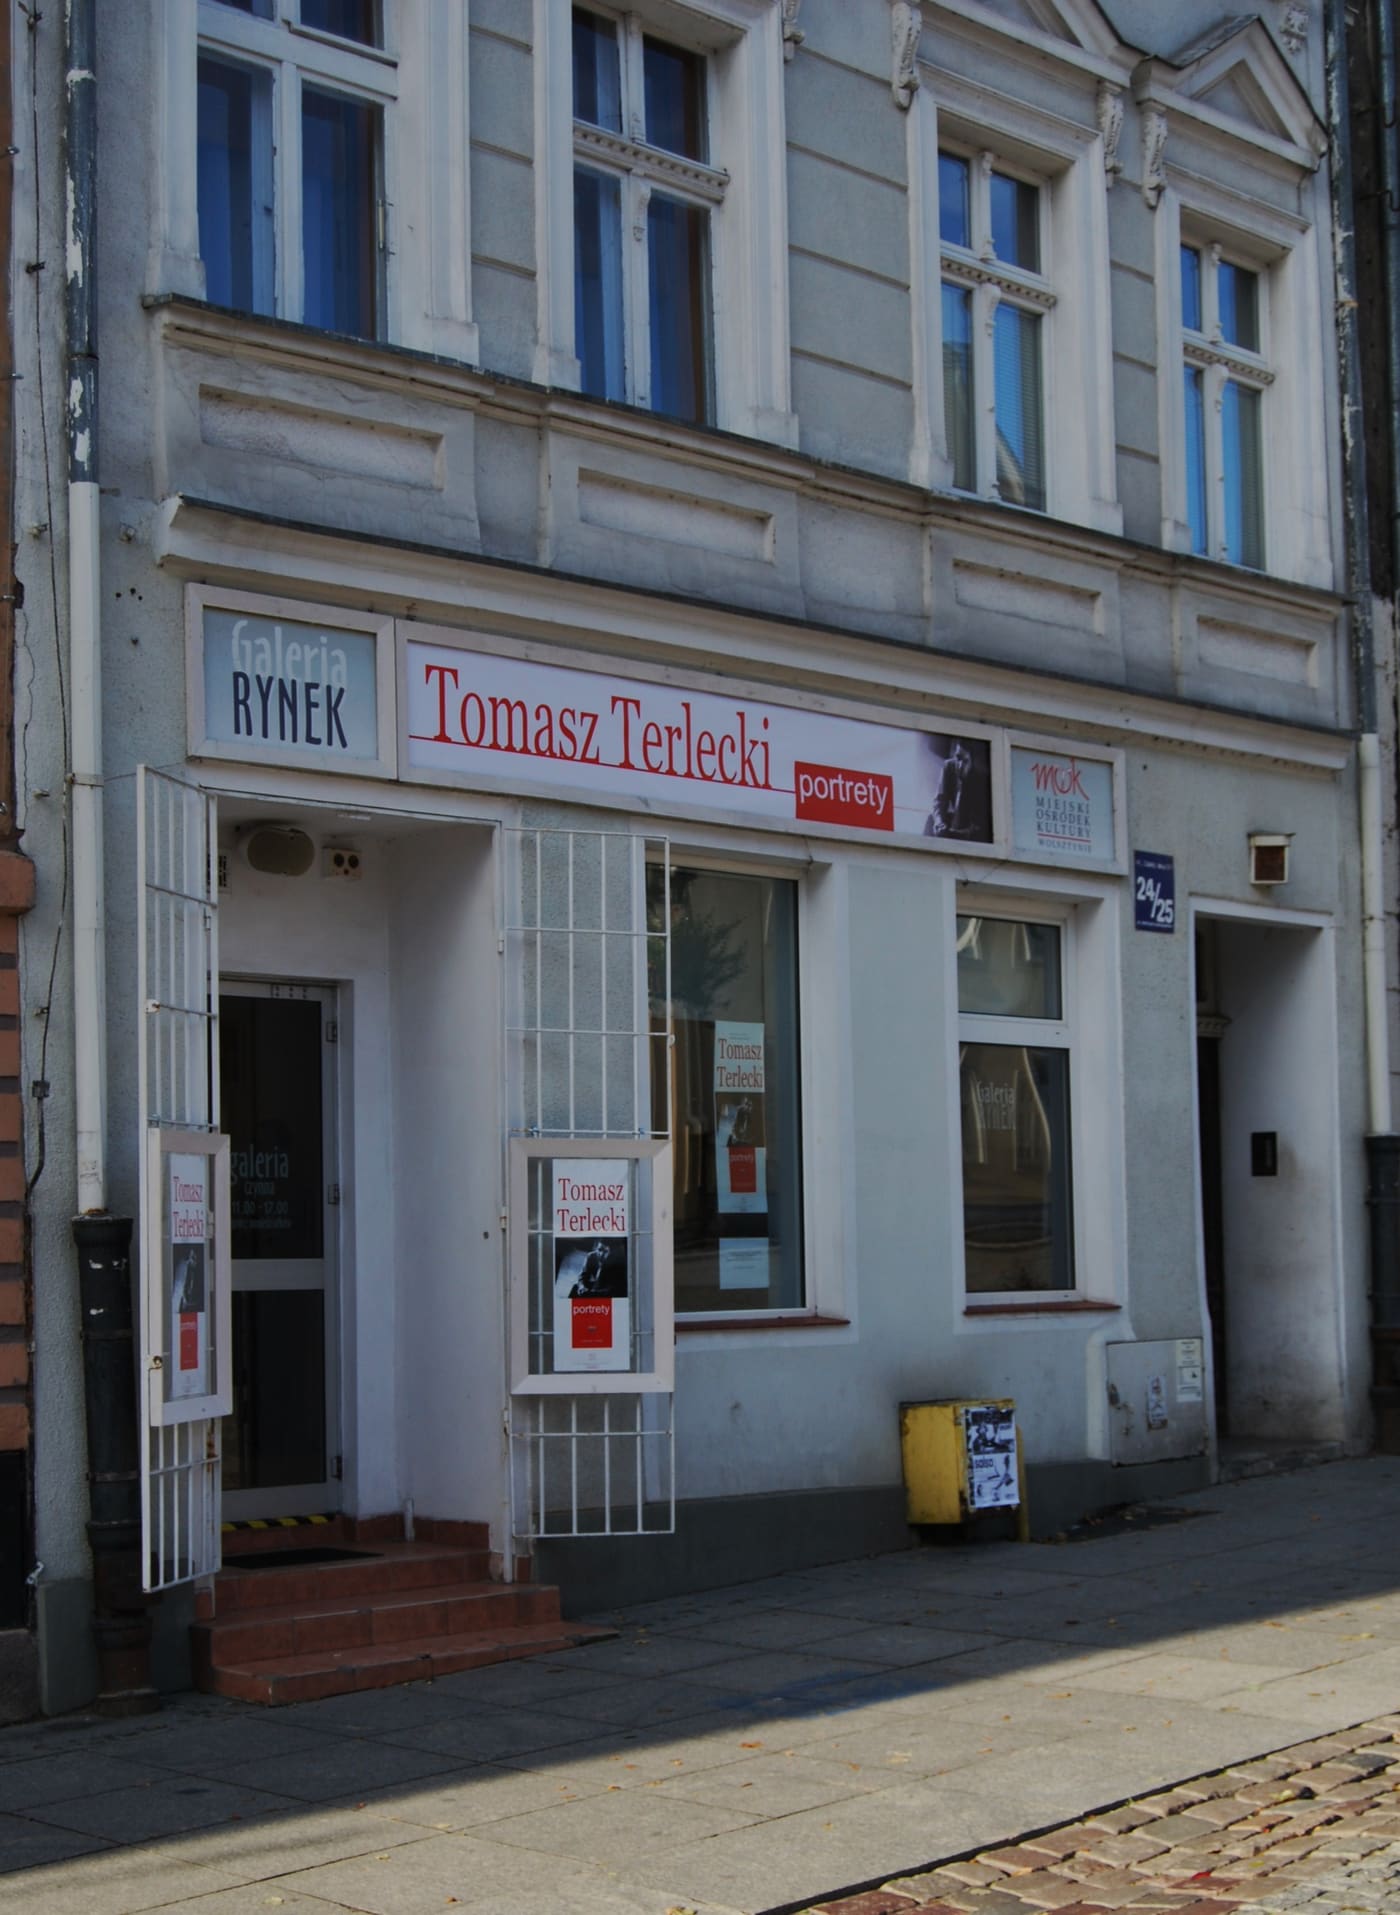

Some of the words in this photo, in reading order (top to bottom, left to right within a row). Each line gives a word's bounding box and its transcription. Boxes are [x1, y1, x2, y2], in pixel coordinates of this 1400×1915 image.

[231, 620, 347, 689] Galeria
[232, 671, 347, 748] RYNEK
[425, 664, 600, 764] Tomasz
[611, 696, 772, 789] Terlecki
[799, 772, 888, 815] portrety
[1036, 796, 1089, 814] MIEJSKI
[1037, 821, 1090, 838] KULTURY
[1137, 876, 1173, 923] 24/25
[718, 1038, 762, 1060] Tomasz
[717, 1065, 763, 1088] Terlecki
[558, 1178, 624, 1201] Tomasz
[557, 1208, 625, 1232] Terlecki
[573, 1304, 610, 1316] portrety
